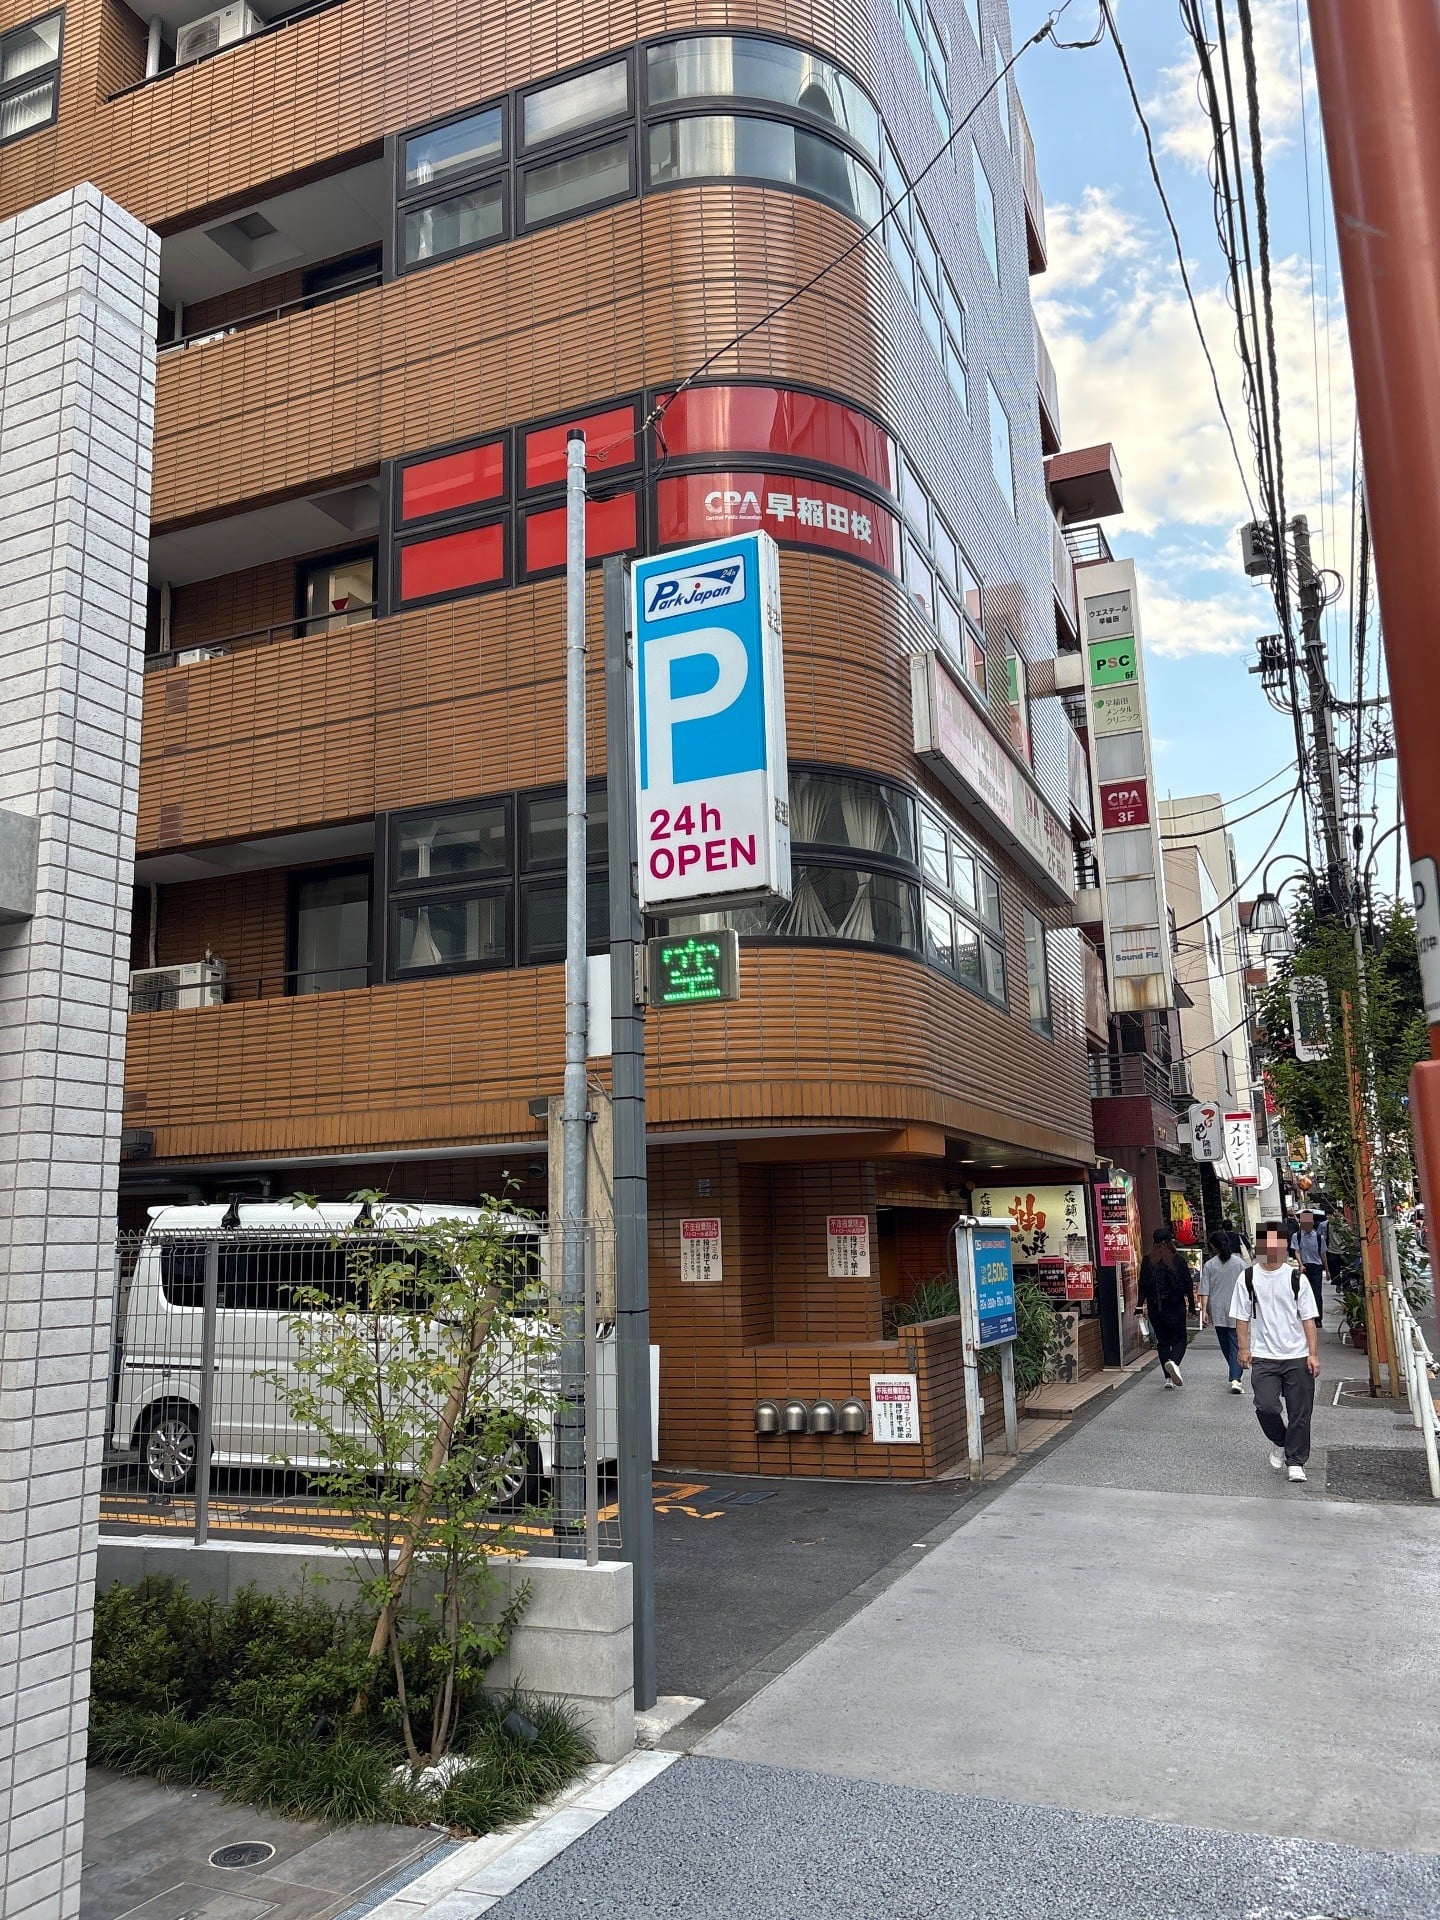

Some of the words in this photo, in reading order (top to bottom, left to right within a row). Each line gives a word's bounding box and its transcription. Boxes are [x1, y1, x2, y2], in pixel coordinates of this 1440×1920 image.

[704, 491, 762, 514] CPA
[766, 492, 872, 544] 早稲田校
[648, 580, 685, 613] Park
[684, 582, 731, 605] Japan
[1099, 615, 1120, 625] 早稲田
[1096, 655, 1130, 671] PSC
[644, 627, 748, 790] P
[1105, 697, 1129, 707] 早稲田
[1106, 705, 1133, 717] メンタル
[1107, 713, 1140, 725] クリニック
[1107, 790, 1142, 806] CPA
[650, 802, 721, 841] 24h
[1117, 811, 1135, 823] 3F
[649, 834, 757, 880] OPEN
[1115, 953, 1143, 961] Sound
[663, 940, 720, 1001] 空
[1229, 1122, 1245, 1176] メルシー
[1104, 1234, 1128, 1245] 学割
[850, 1236, 858, 1276] 投げ捨て禁止
[1067, 1271, 1092, 1284] 学割
[896, 1403, 904, 1439] 投げ捨て禁止
